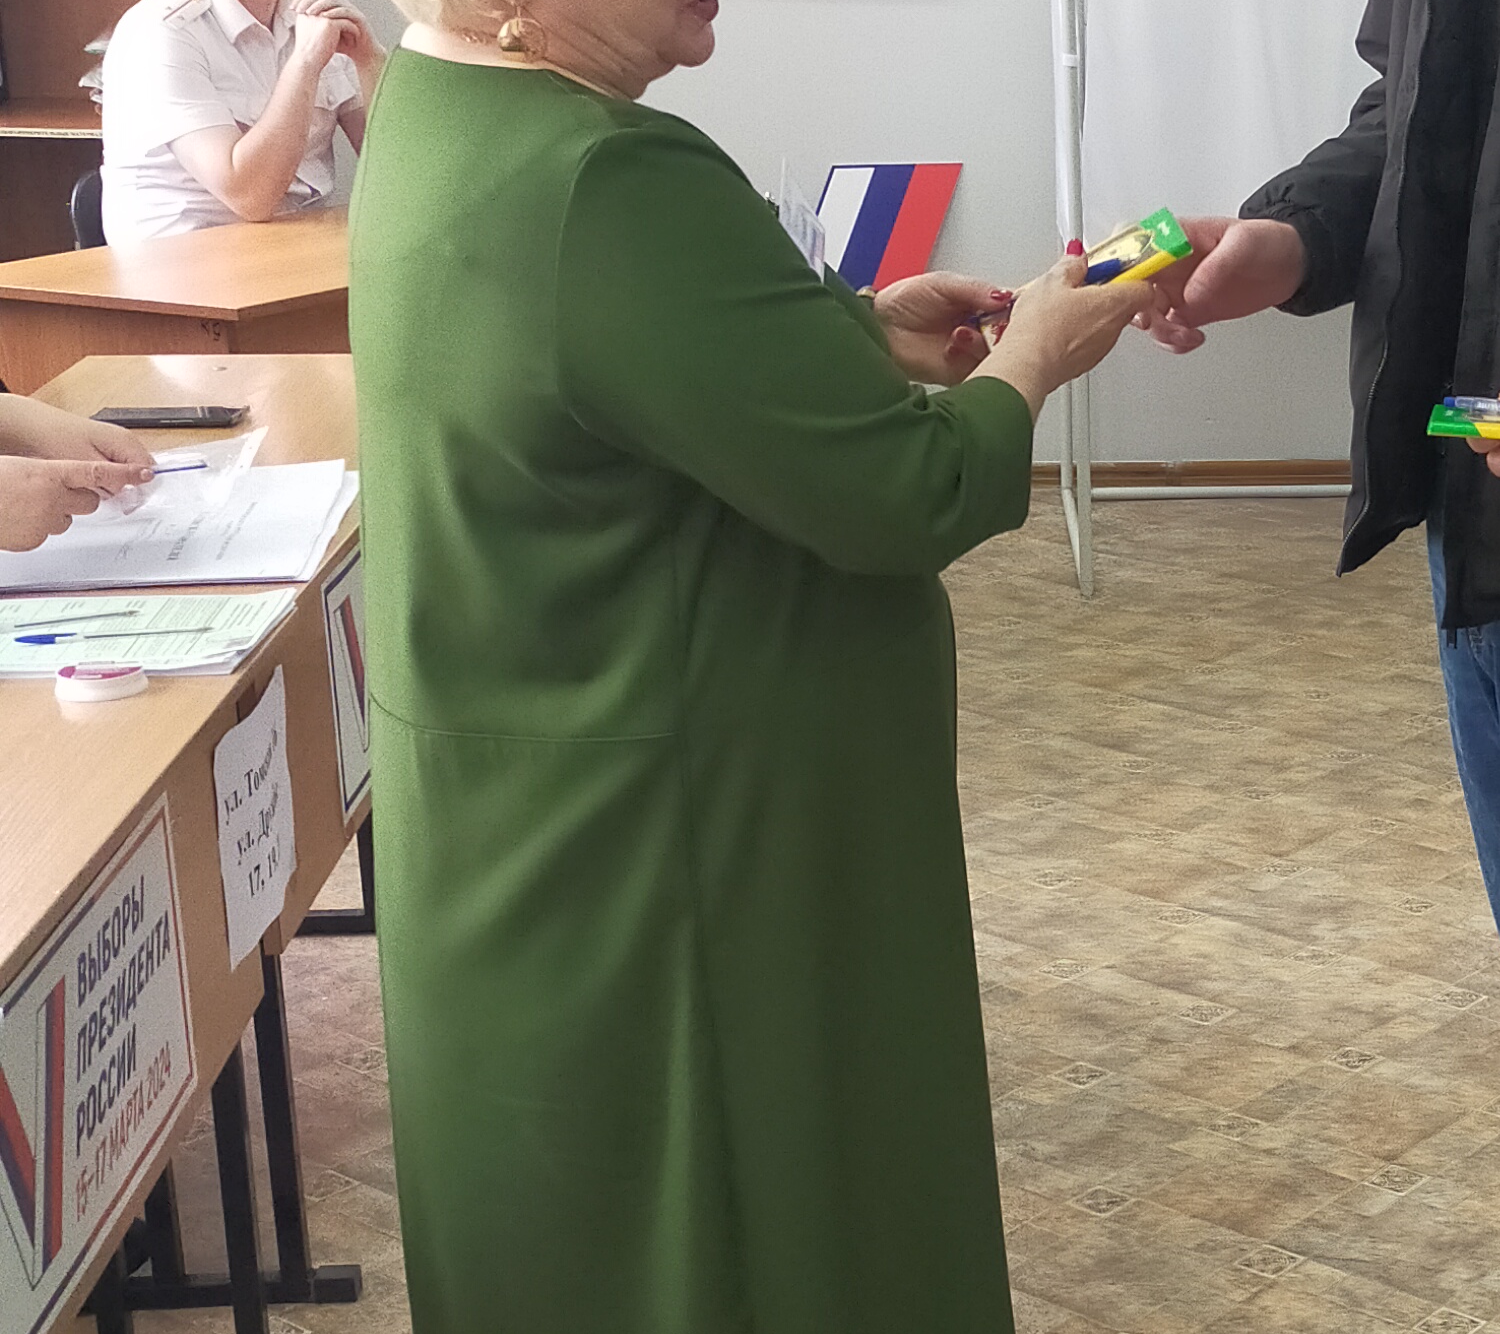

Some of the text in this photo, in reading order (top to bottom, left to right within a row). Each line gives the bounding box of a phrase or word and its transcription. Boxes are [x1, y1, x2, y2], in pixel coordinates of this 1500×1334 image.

[76, 910, 171, 1083] ПРЕЗИДЕНТА
[77, 874, 145, 1008] ВЫБОРЫ
[76, 1022, 137, 1158] РОССИИ
[109, 1079, 145, 1171] МАРТА
[146, 1040, 172, 1112] 2024
